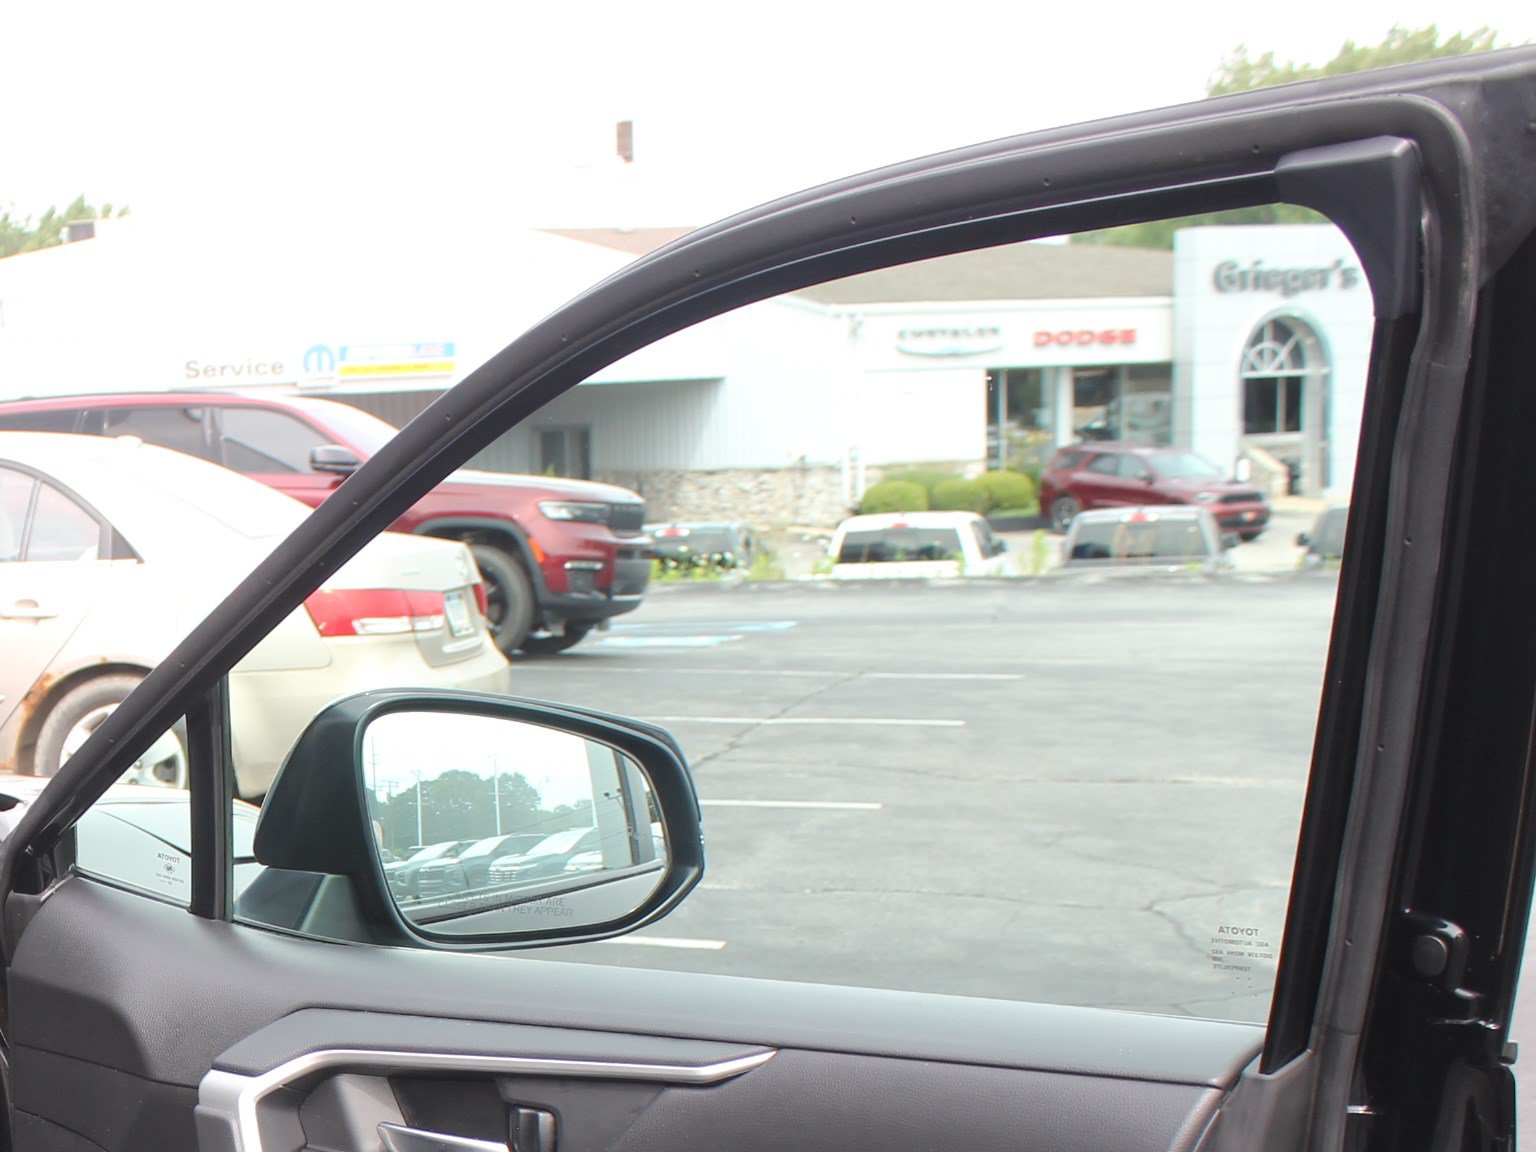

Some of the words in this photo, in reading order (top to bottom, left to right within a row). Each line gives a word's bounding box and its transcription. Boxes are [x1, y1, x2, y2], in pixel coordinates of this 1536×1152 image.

[1033, 328, 1137, 347] DODGE
[185, 357, 285, 379] Service
[546, 896, 565, 907] ARE
[534, 906, 574, 917] APPEAR
